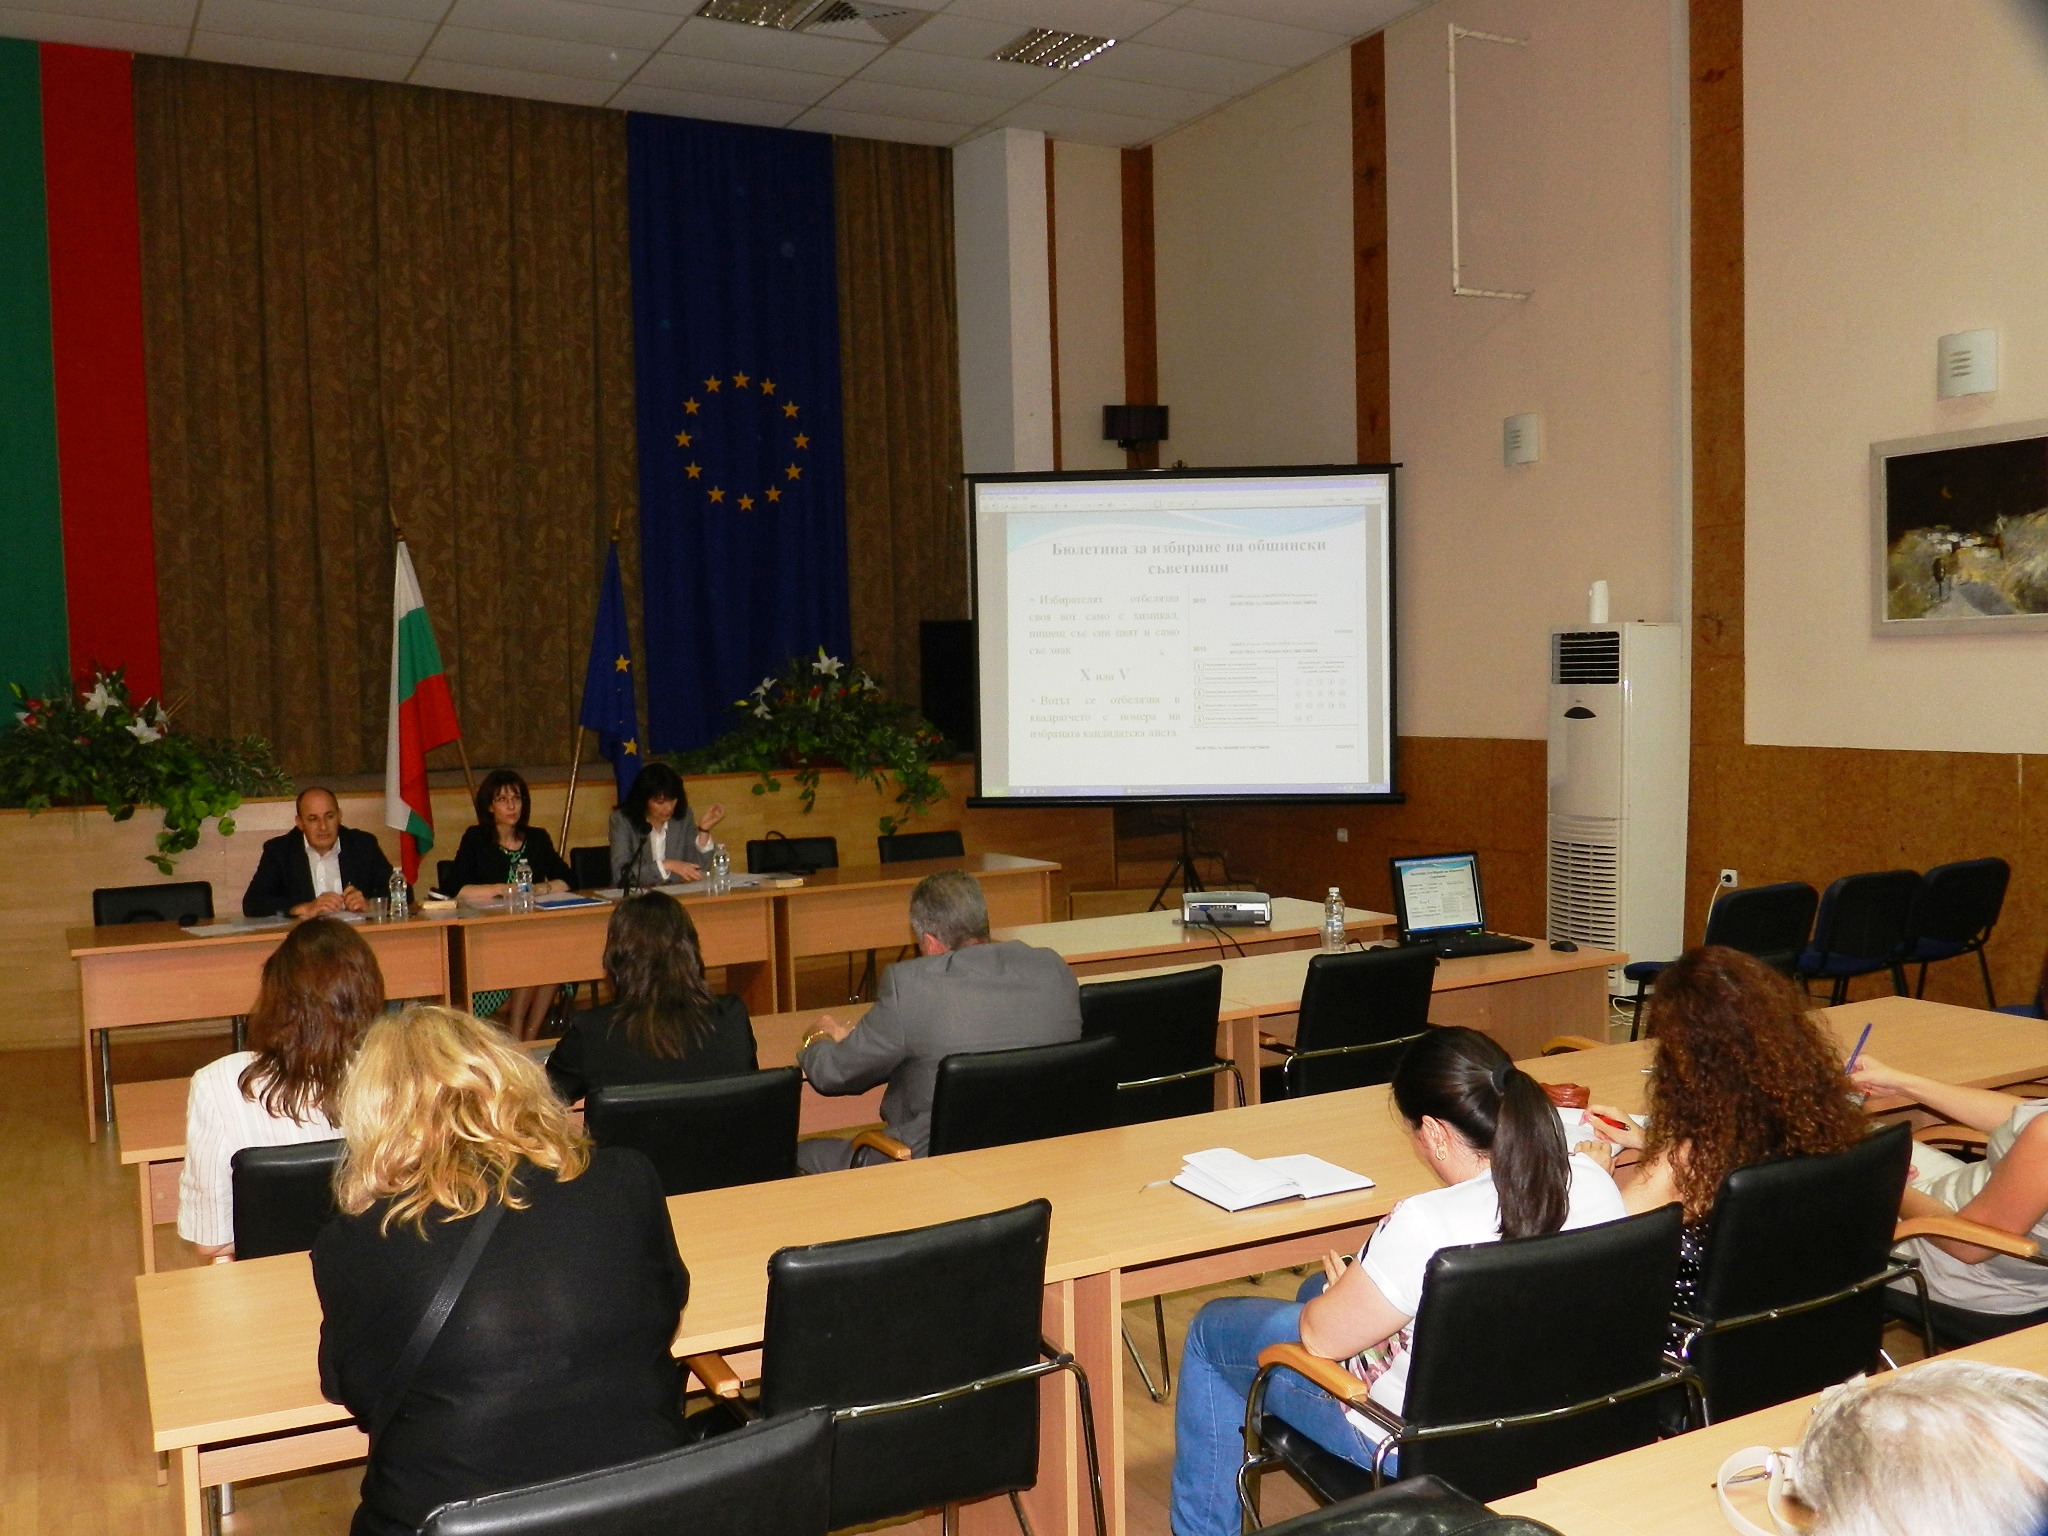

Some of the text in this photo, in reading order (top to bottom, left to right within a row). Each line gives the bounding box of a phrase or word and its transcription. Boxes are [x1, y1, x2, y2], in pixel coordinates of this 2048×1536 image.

[1133, 545, 1147, 555] за
[1152, 541, 1222, 556] избиране
[1226, 543, 1243, 554] на
